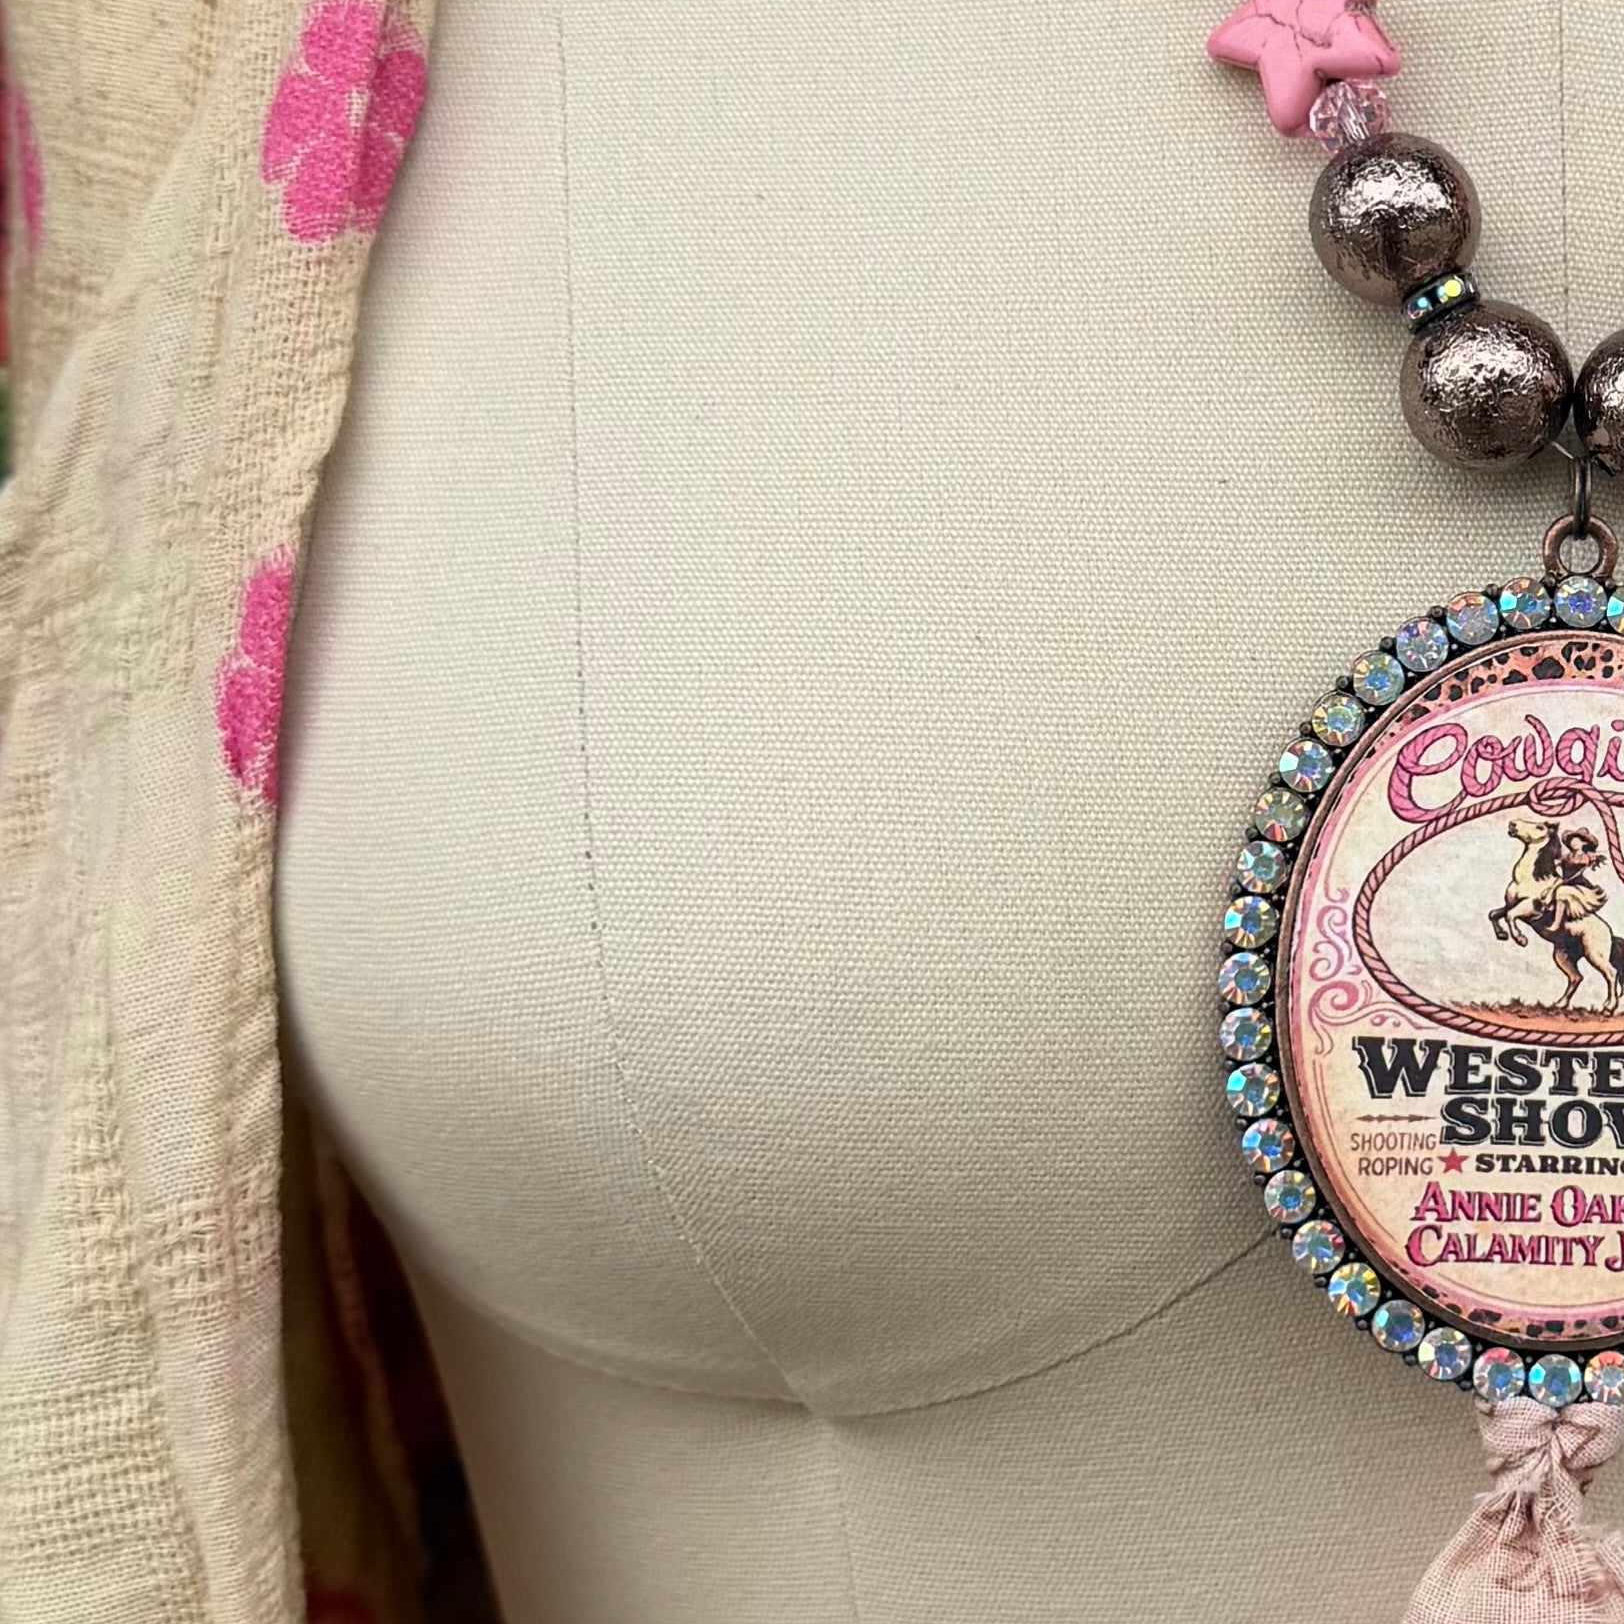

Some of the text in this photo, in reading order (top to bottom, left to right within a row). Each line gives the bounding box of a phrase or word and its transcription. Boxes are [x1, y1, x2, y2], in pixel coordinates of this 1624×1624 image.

[1350, 1131, 1437, 1153] SHOOTING
[1357, 1156, 1434, 1177] ROPING
[1410, 1180, 1542, 1224] ANNIE
[1405, 1224, 1605, 1269] CALAMITY
